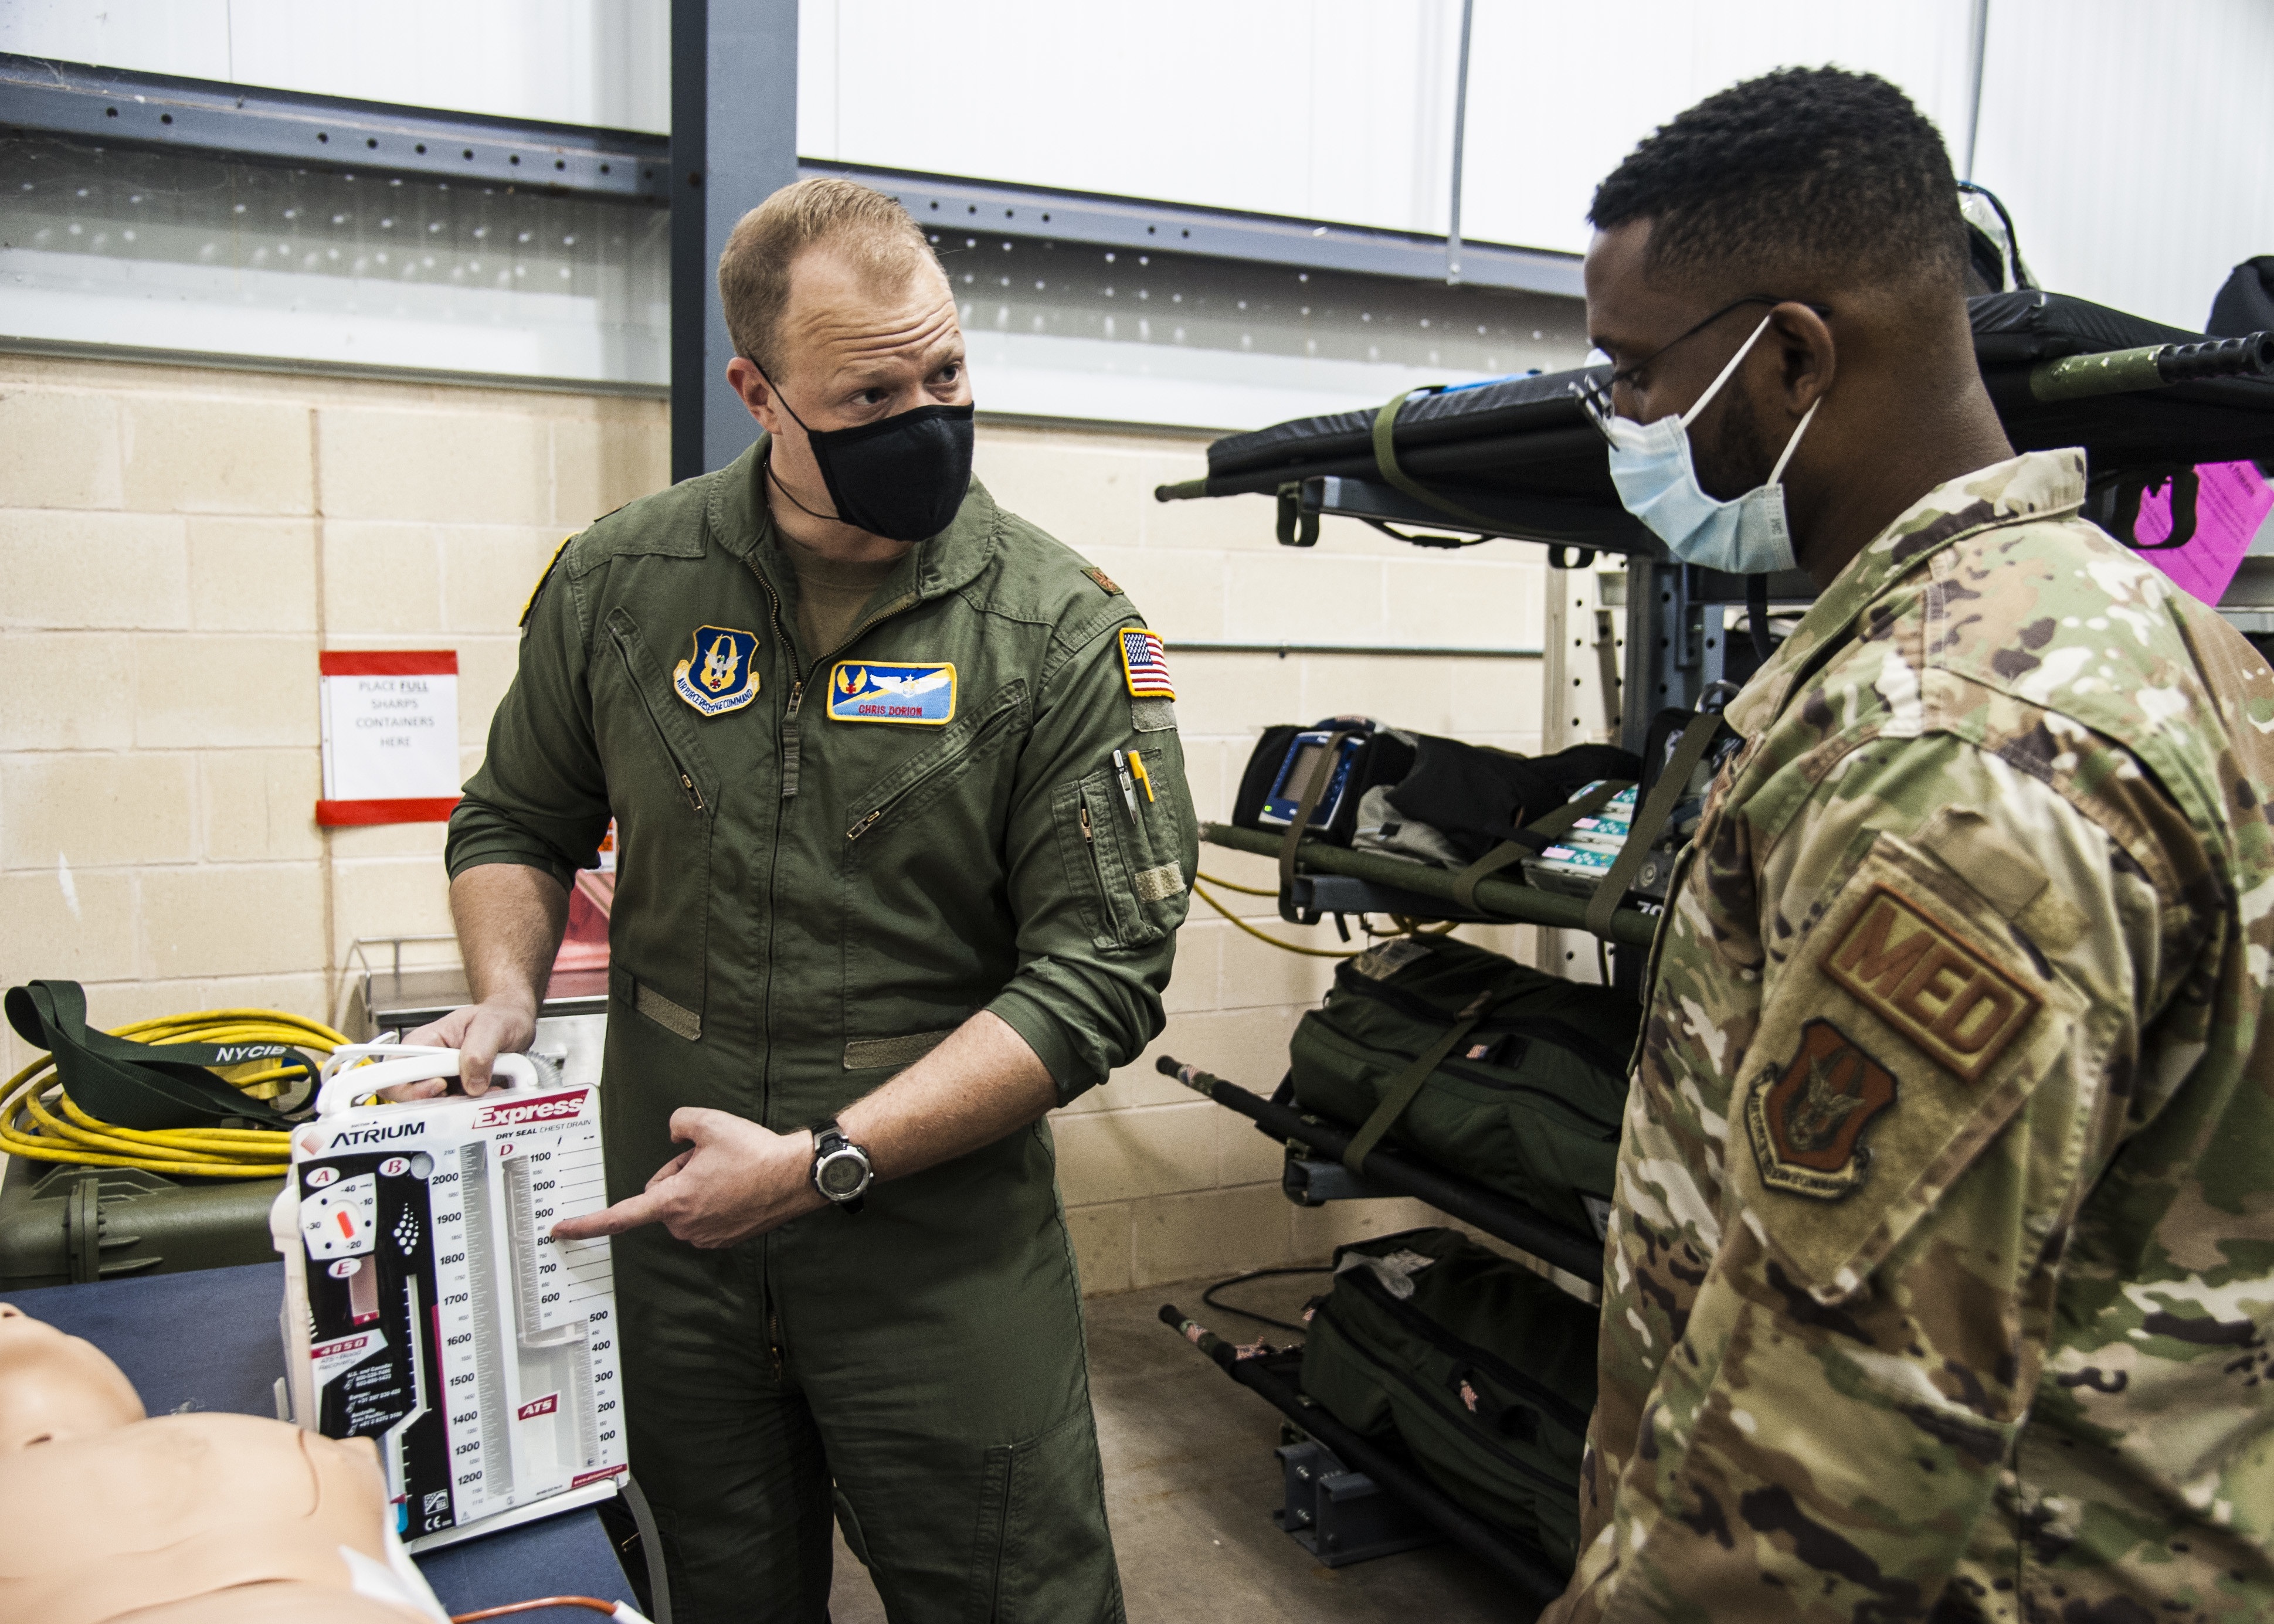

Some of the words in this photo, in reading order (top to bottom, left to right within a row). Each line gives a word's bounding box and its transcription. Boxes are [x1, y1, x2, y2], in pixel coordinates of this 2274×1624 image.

[359, 681, 395, 692] PLACE
[400, 680, 429, 692] FULL
[676, 677, 686, 691] AIR
[682, 687, 701, 704] FORCE
[697, 698, 723, 714] RESERVE
[724, 688, 754, 708] COMMAND
[371, 698, 418, 709] SHARPS
[858, 705, 886, 715] CHRIS
[888, 705, 922, 717] DORION
[355, 717, 435, 729] CONTAINERS
[381, 737, 411, 748] HERE
[1838, 906, 2017, 1055] MED
[216, 1045, 287, 1062] NYCIB
[476, 1098, 584, 1127] Express
[330, 1122, 425, 1149] ATRIUM
[495, 1132, 514, 1140] DRY
[539, 1123, 565, 1133] CHEST
[566, 1119, 592, 1129] DRAIN
[500, 1144, 514, 1156] D
[530, 1151, 551, 1163] 1100
[388, 1160, 403, 1174] B
[315, 1170, 329, 1184] A
[432, 1173, 459, 1185] 2000
[533, 1180, 555, 1191] 1000
[437, 1211, 462, 1225] 1900
[535, 1208, 554, 1219] 900
[306, 1221, 321, 1230] -30
[347, 1241, 361, 1249] -20
[538, 1235, 556, 1246] 800
[440, 1252, 465, 1265] 1800
[337, 1261, 351, 1275] E
[539, 1263, 557, 1274] 700
[444, 1292, 469, 1306] 1700
[541, 1292, 560, 1303] 600
[589, 1310, 608, 1322] 500
[447, 1333, 471, 1346] 1600
[592, 1340, 610, 1352] 400
[320, 1338, 365, 1355] 4050
[450, 1372, 474, 1387] 1500
[595, 1370, 613, 1382] 300
[522, 1399, 552, 1417] ATS
[597, 1400, 616, 1413] 200
[453, 1411, 478, 1425] 1400
[599, 1430, 616, 1442] 100
[456, 1440, 480, 1455] 1300
[458, 1470, 483, 1485] 1200
